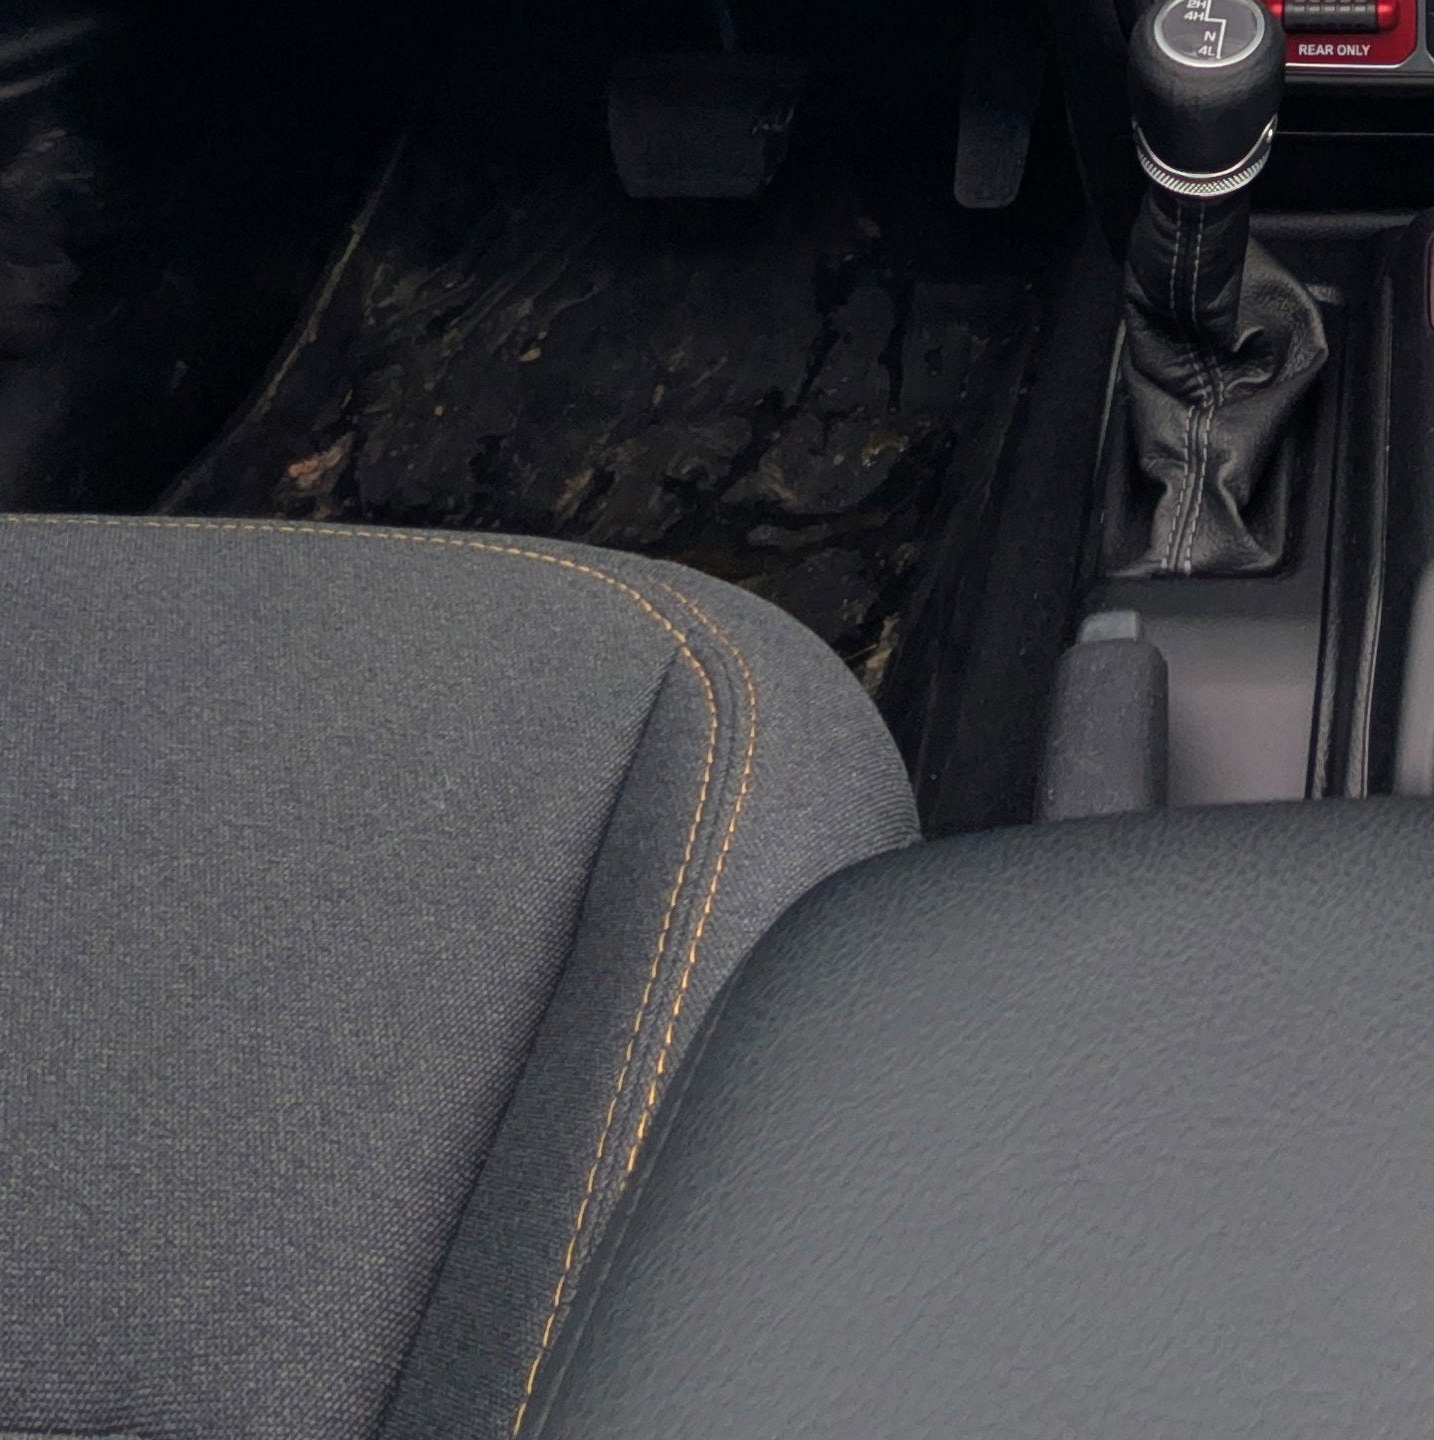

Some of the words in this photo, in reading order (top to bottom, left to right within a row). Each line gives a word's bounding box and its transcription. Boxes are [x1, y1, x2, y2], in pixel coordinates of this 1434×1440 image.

[1186, 0, 1207, 9] 2H
[1184, 10, 1206, 21] 4H
[1203, 30, 1216, 42] N
[1198, 45, 1216, 56] 4L
[1298, 43, 1334, 55] REAR
[1336, 44, 1371, 56] ONLY
